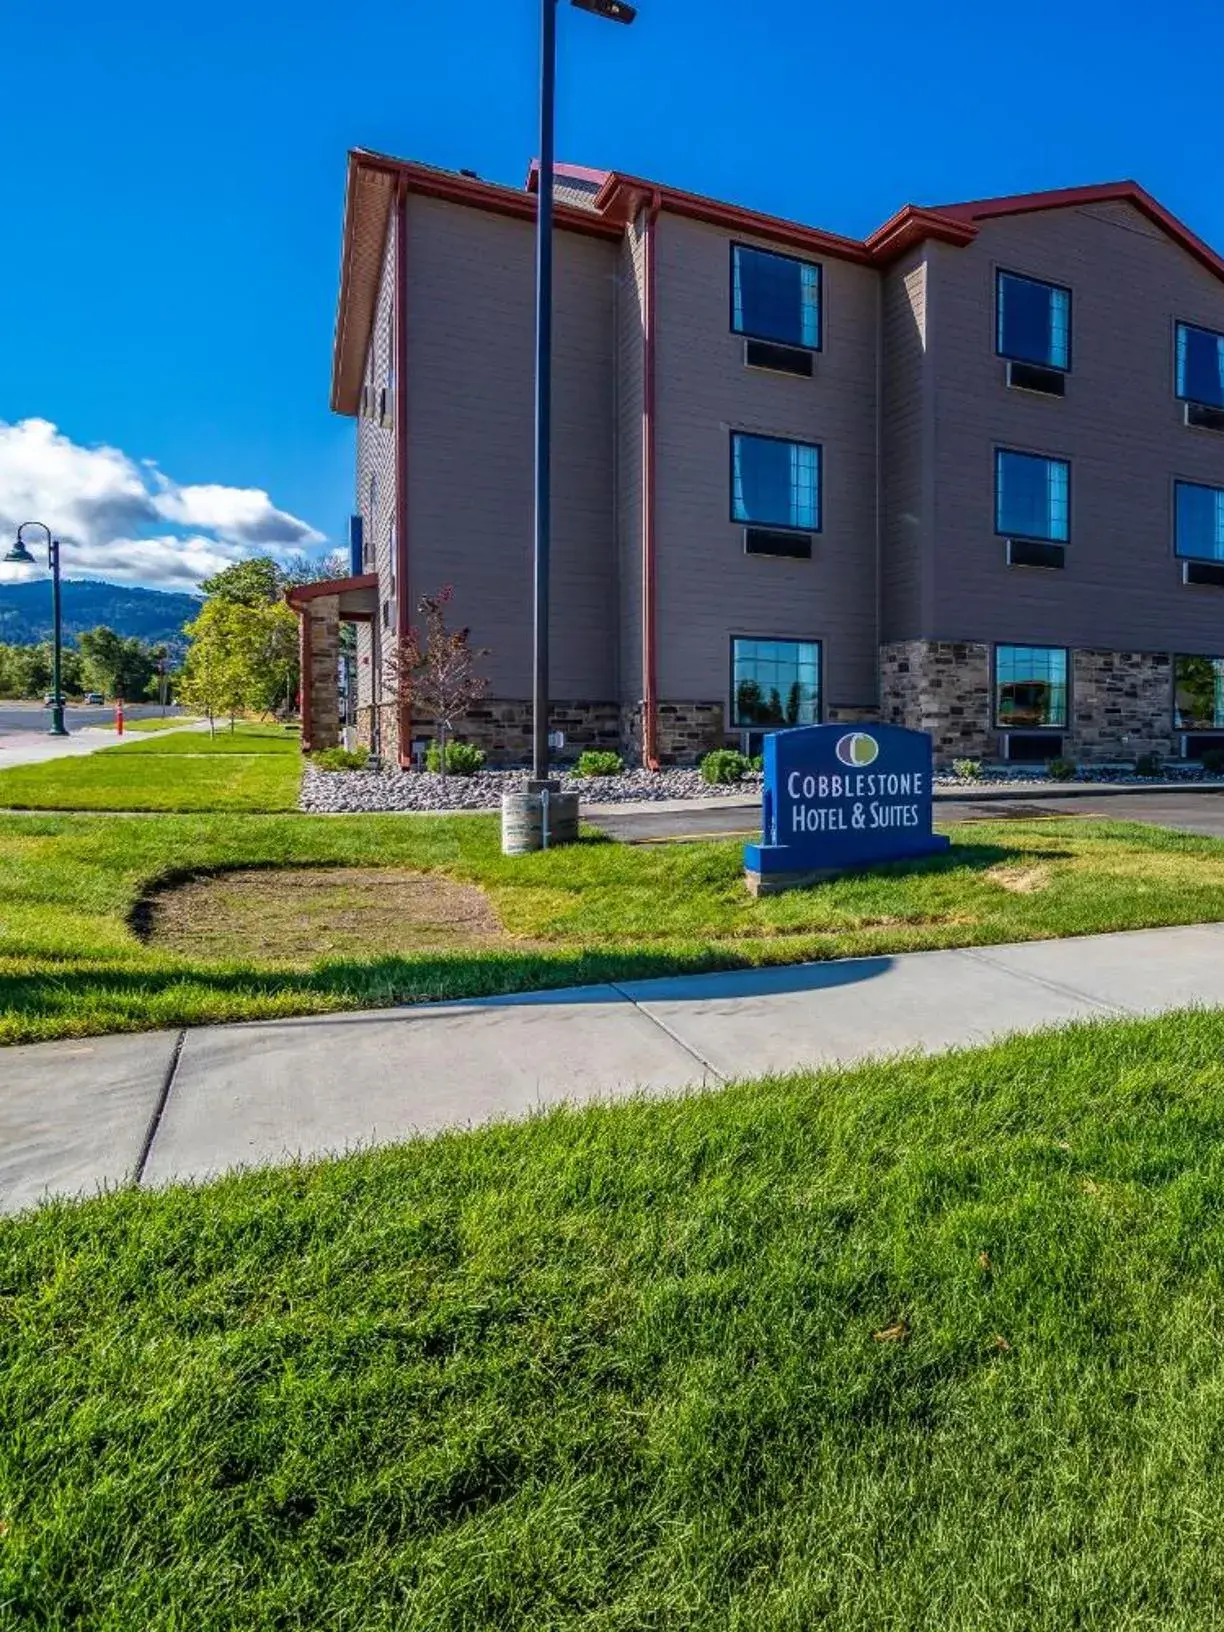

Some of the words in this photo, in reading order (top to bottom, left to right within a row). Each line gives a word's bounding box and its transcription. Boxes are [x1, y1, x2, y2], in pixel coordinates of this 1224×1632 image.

[787, 771, 923, 799] COBBLESTONE
[792, 804, 848, 832] HOTEL
[851, 802, 866, 829] &
[869, 801, 919, 828] SUITES
